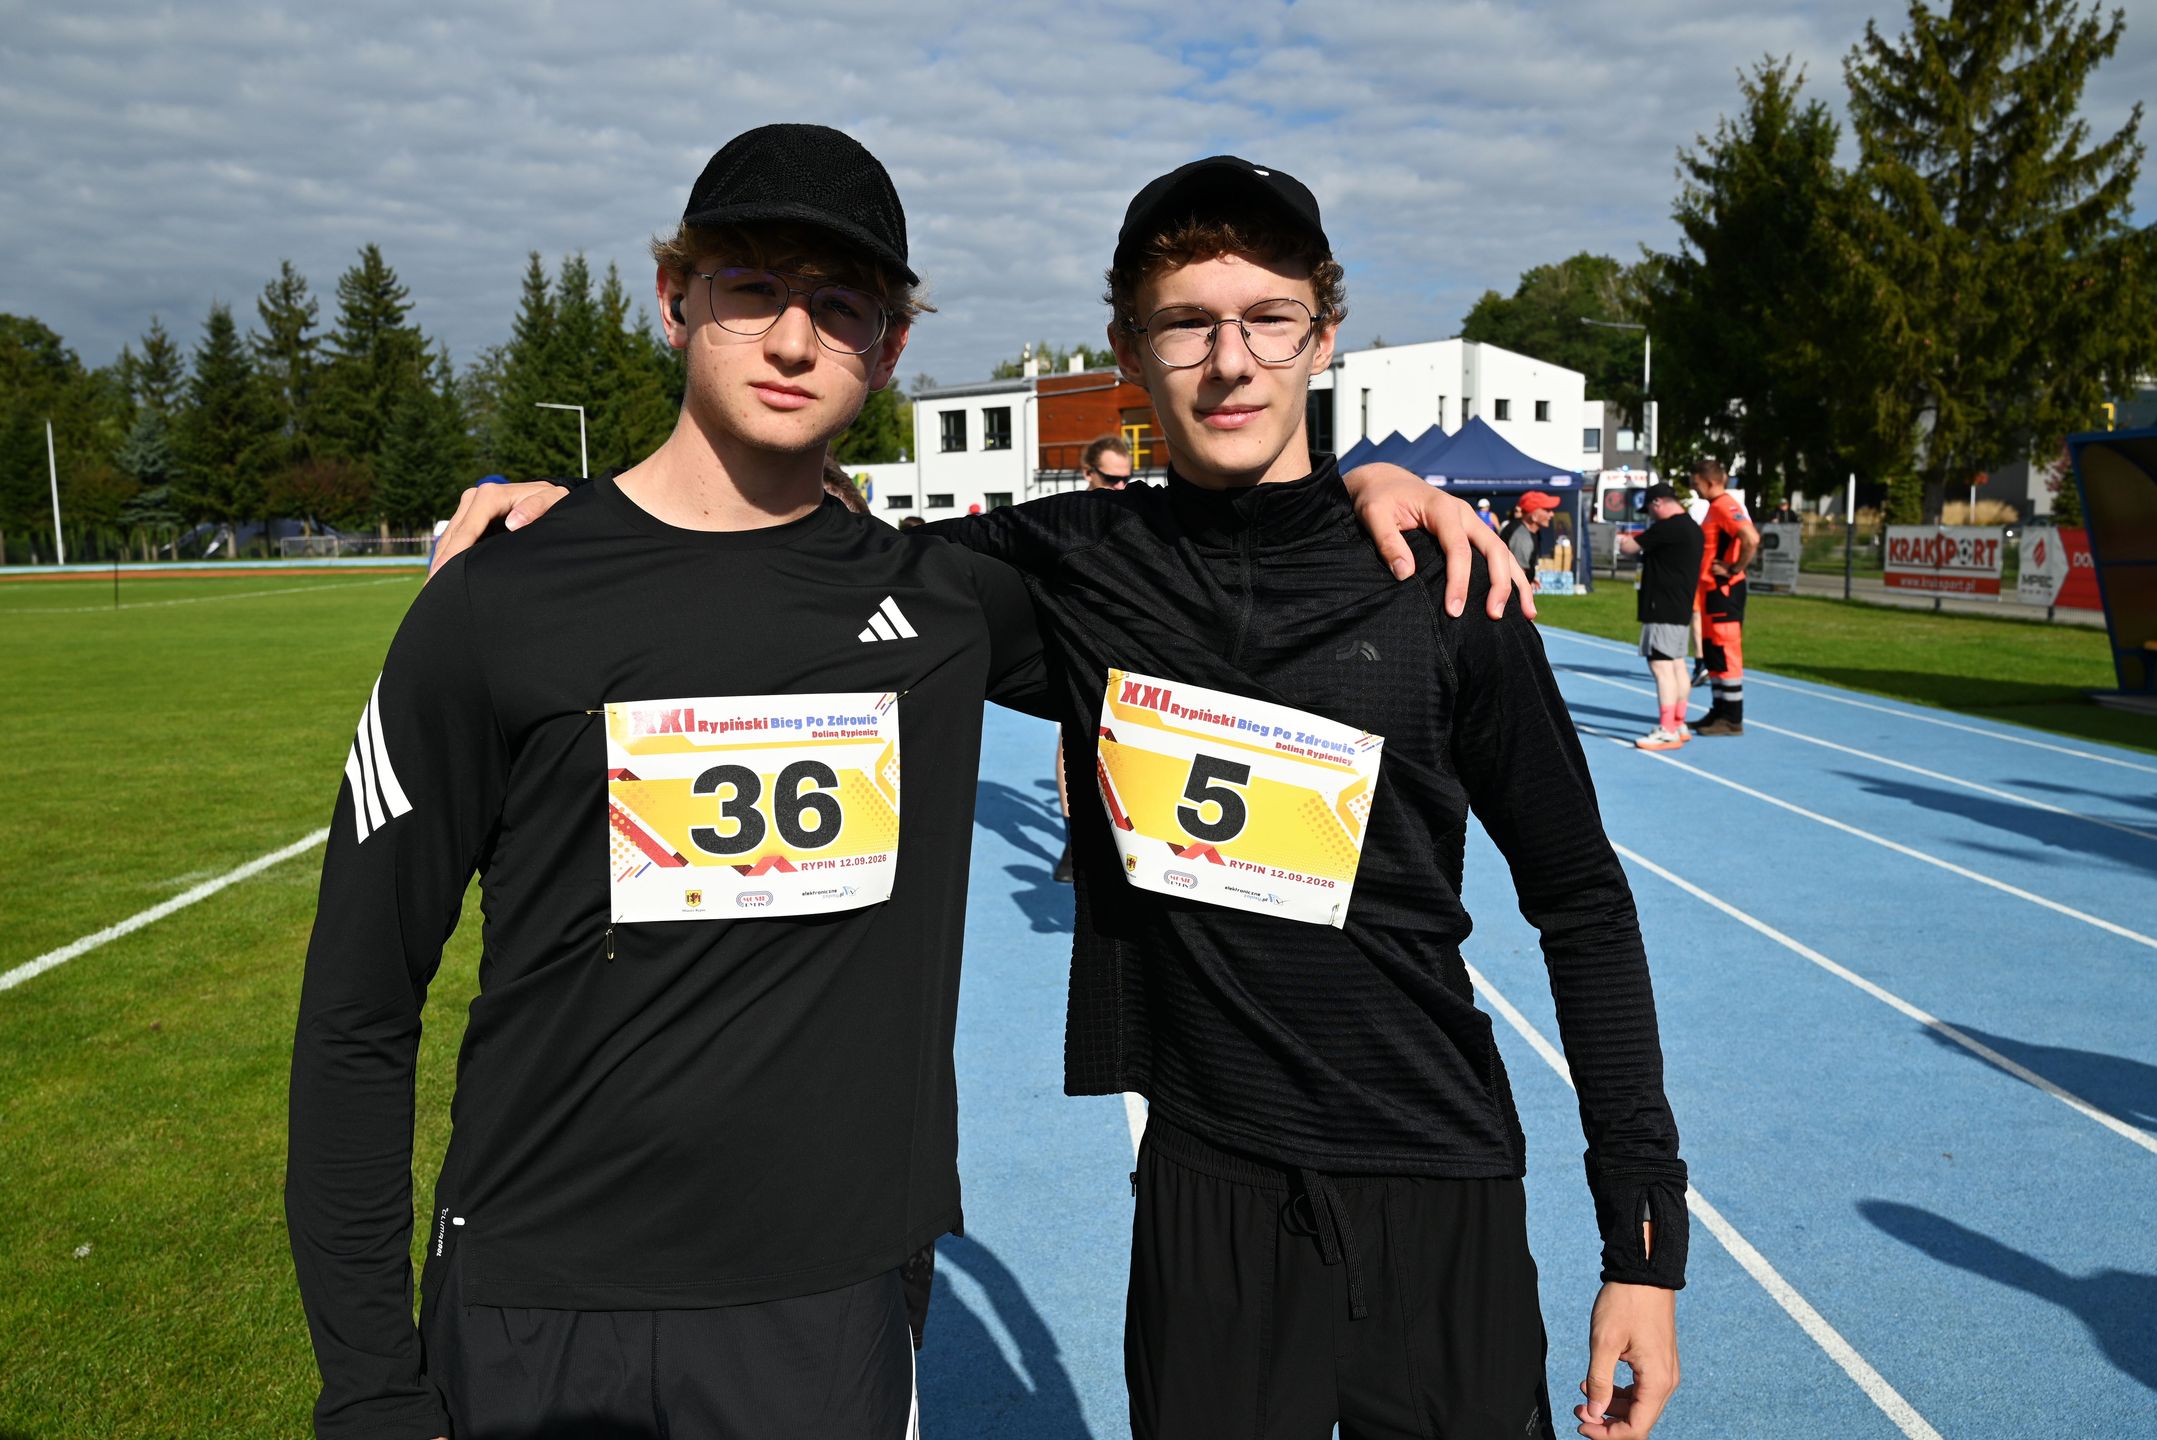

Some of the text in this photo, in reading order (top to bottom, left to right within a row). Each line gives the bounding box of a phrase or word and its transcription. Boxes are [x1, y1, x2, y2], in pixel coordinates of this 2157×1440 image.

[631, 708, 878, 735] XXI Rypiński Bieg Po Zdrowie
[1120, 681, 1355, 755] XXI Rypiński Bieg Po Zdrowie
[691, 760, 842, 855] 36
[1177, 753, 1251, 842] 5
[801, 854, 887, 871] RYPIN 12.09.2026
[1229, 860, 1335, 890] RYPIN 12.09.2026
